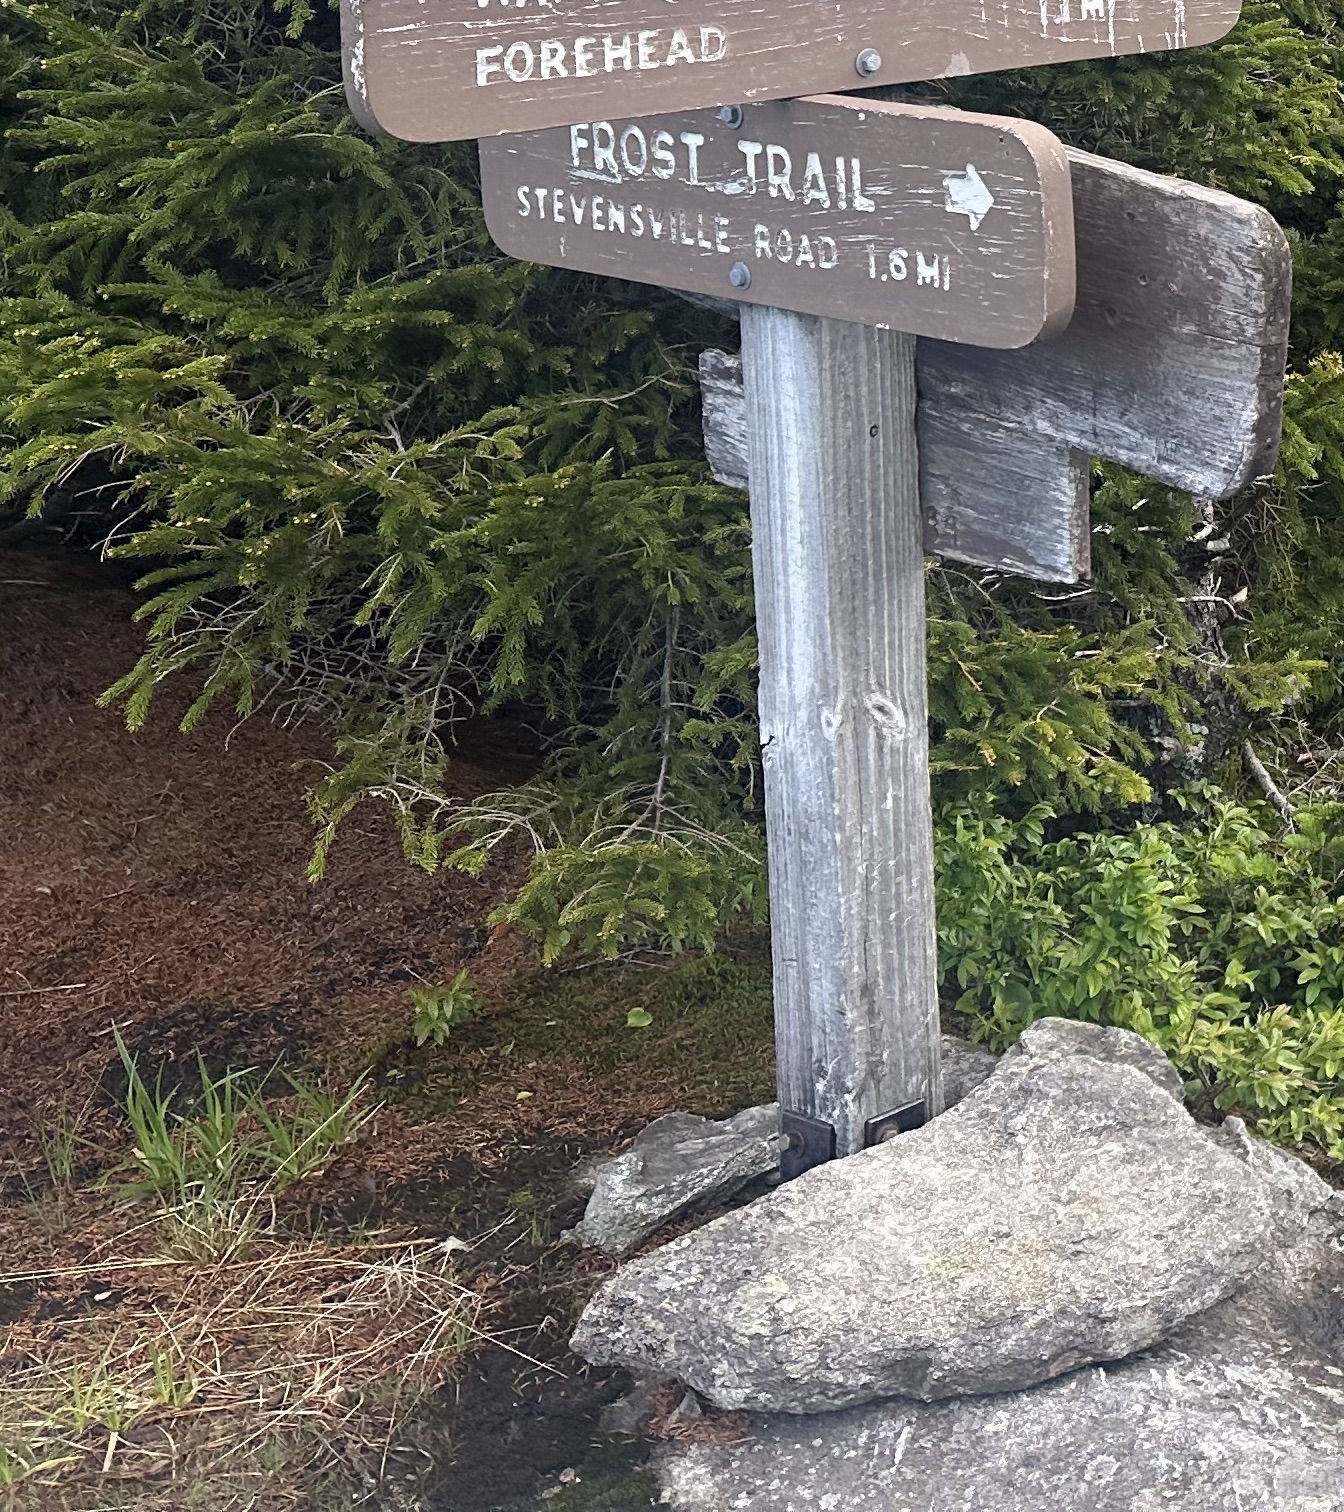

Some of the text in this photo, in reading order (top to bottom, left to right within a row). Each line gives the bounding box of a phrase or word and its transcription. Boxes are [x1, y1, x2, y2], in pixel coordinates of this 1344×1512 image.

[475, 25, 728, 87] FOREHEAD
[569, 122, 876, 212] FROST TRAIL
[516, 184, 951, 291] STEVENSVILLE ROAD 1.6 MI
